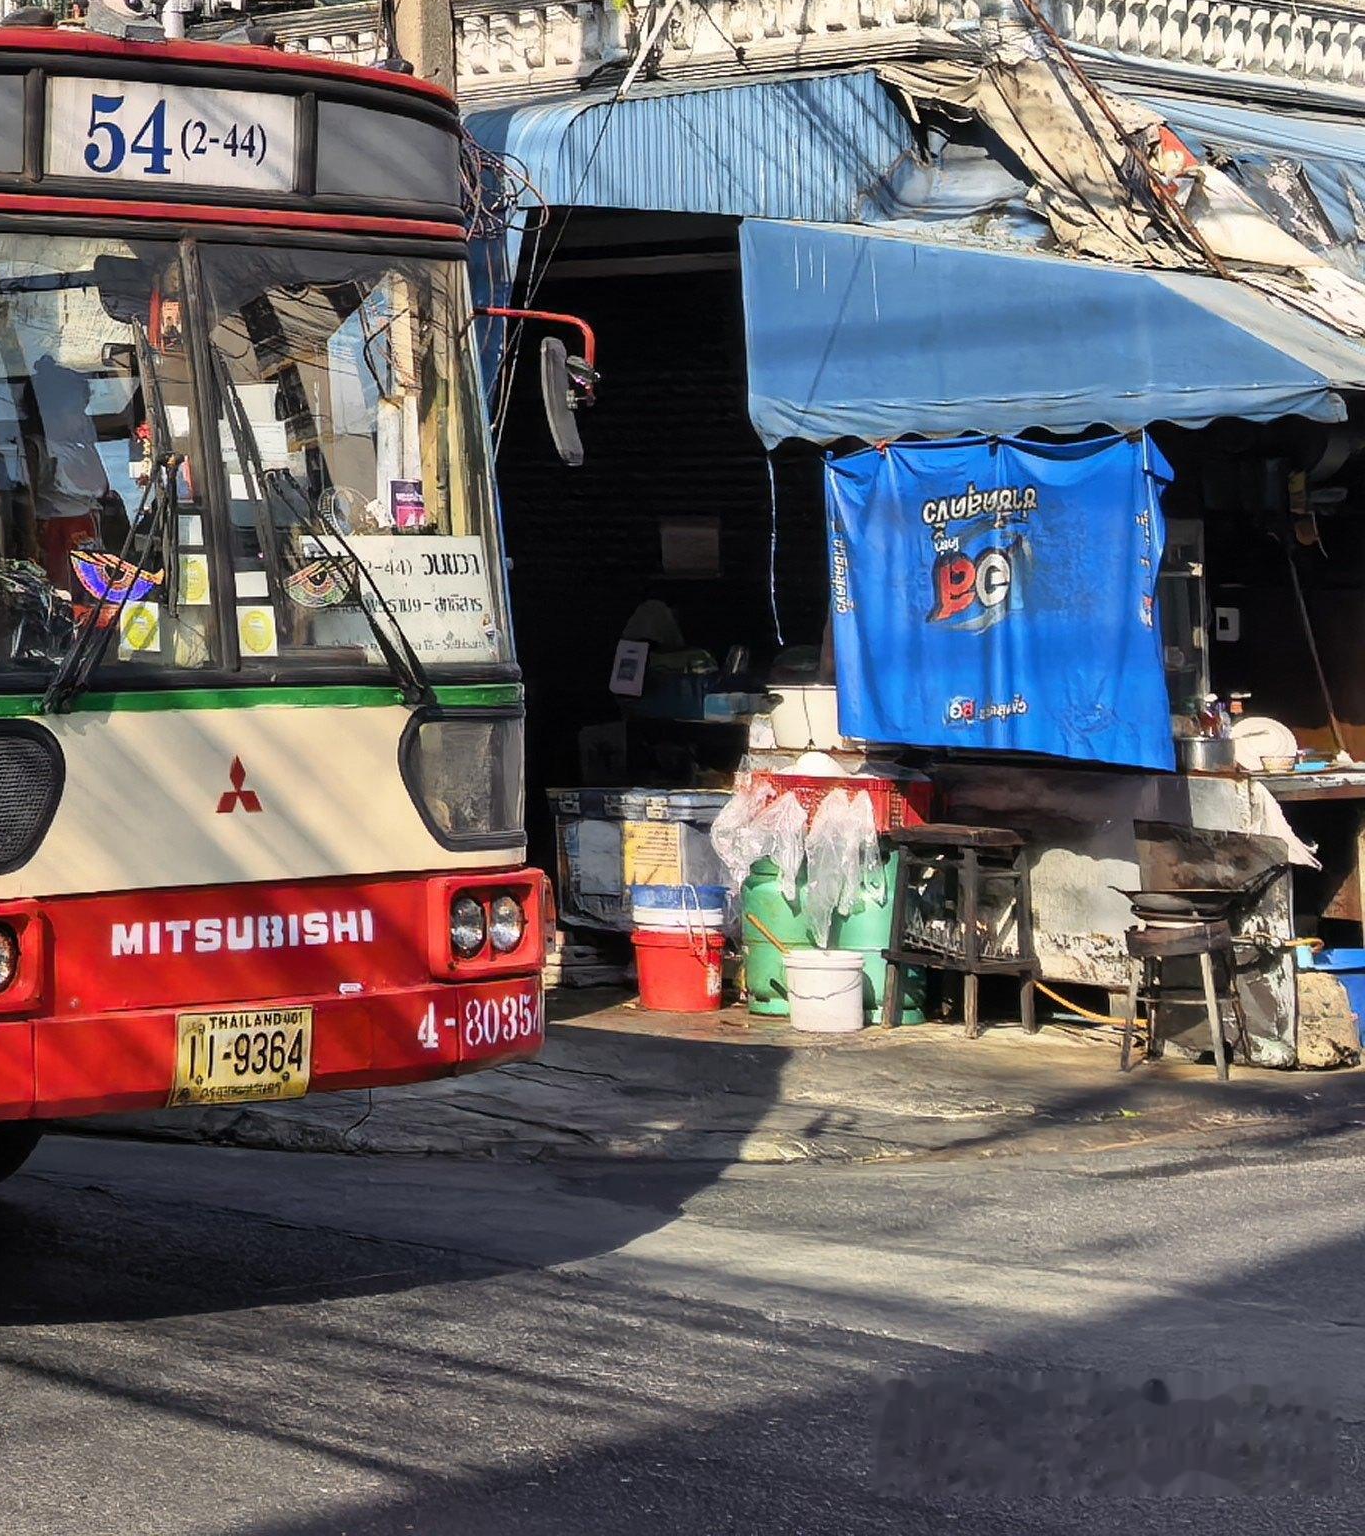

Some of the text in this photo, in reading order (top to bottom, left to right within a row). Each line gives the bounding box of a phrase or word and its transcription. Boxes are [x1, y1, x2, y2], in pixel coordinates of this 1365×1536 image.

[84, 93, 267, 175] 54 (2-44)
[111, 909, 373, 957] MITSUBISHI
[208, 1013, 281, 1030] THAILAND
